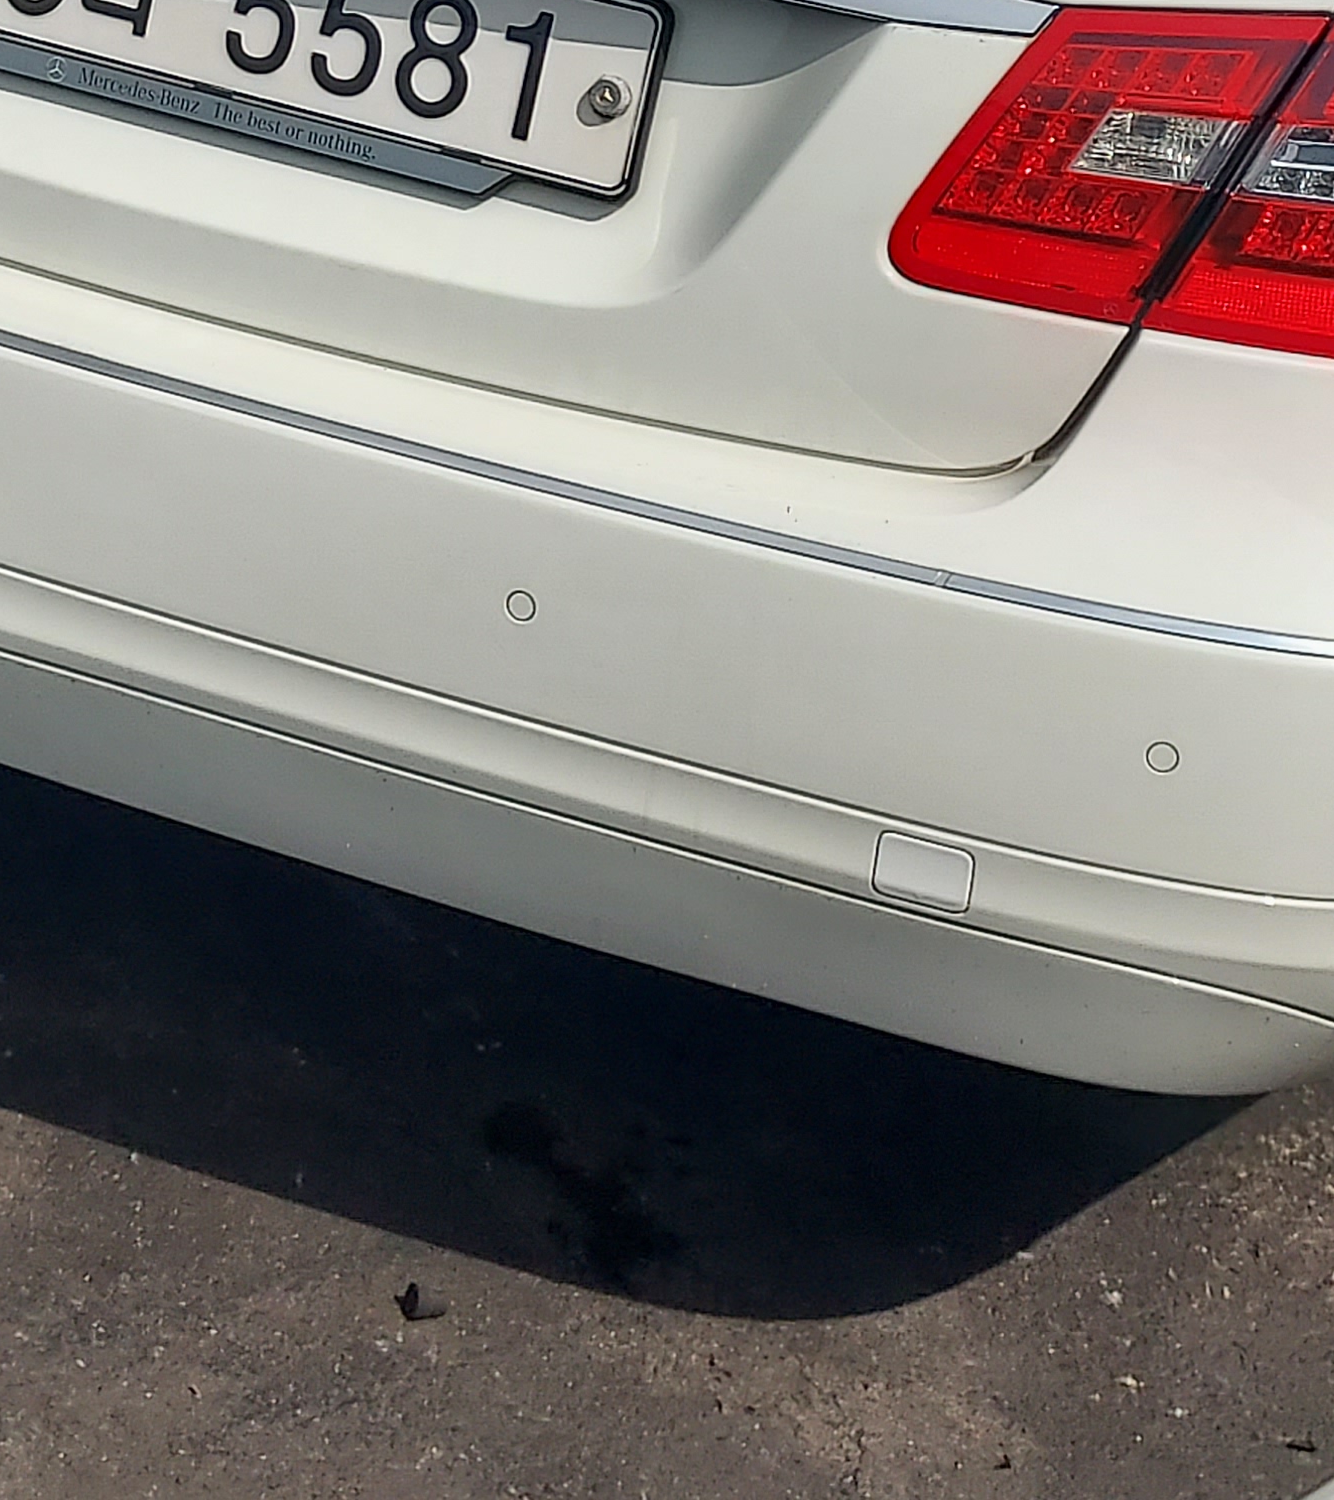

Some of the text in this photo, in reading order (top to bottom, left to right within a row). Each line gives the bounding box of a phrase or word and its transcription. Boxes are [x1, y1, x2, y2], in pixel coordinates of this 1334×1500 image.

[77, 66, 377, 160] Mercedes-Benz The best or nothing.
